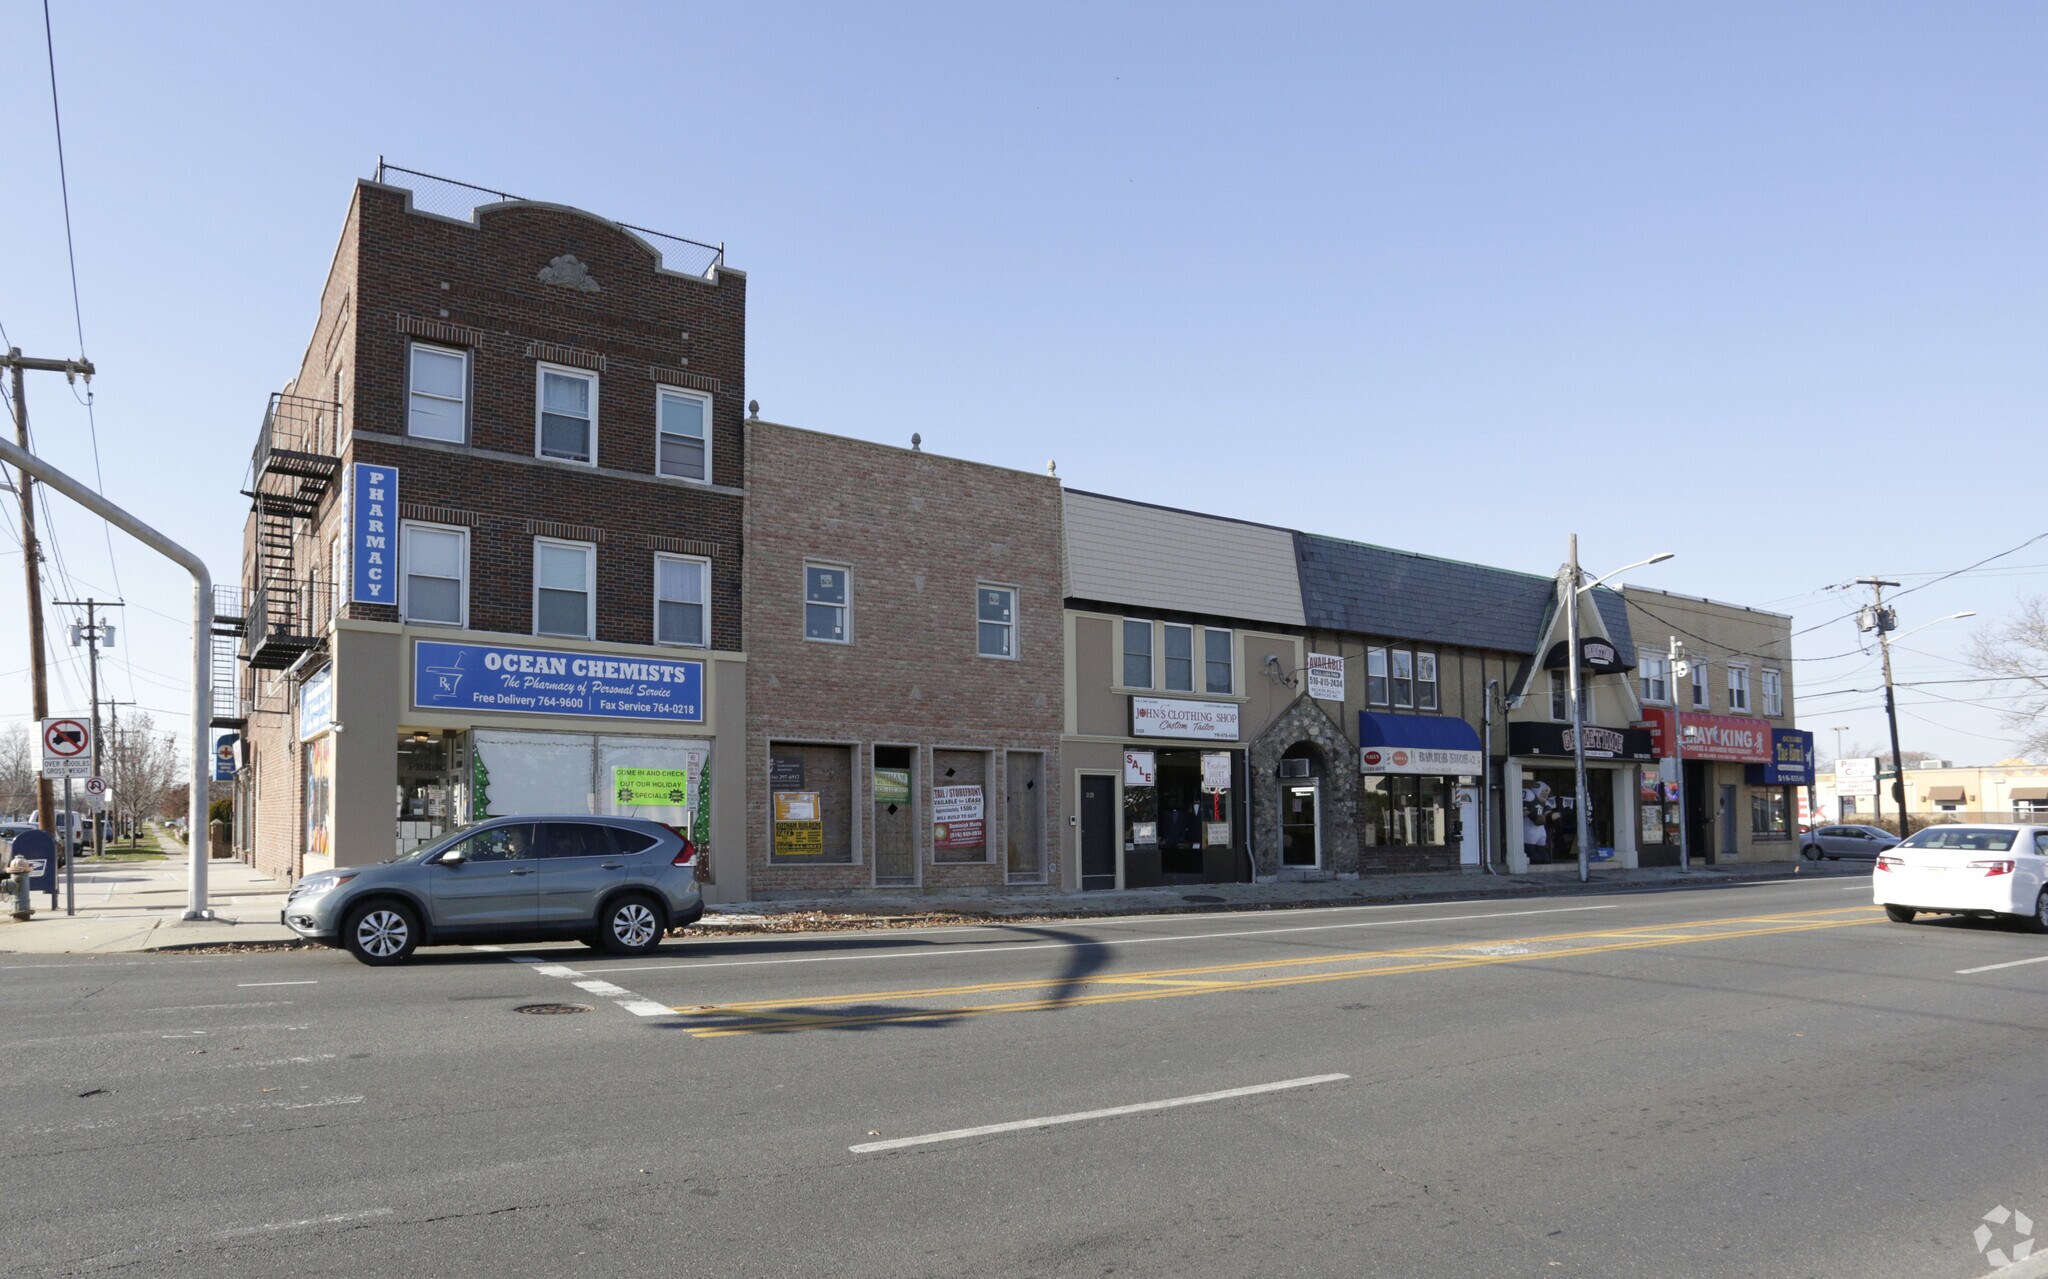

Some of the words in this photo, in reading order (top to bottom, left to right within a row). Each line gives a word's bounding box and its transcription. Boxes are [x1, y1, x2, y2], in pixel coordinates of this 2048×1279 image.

[366, 471, 385, 597] PHARMACY
[484, 652, 566, 675] OCEAN
[571, 659, 686, 684] CHEMISTS
[1309, 656, 1343, 671] AVAILABLE
[501, 674, 520, 688] The
[523, 676, 575, 694] Pharmacy
[577, 681, 588, 696] of
[591, 681, 634, 695] Personal
[636, 684, 671, 698] Service
[473, 692, 495, 704] Free
[497, 693, 536, 708] Delivery
[538, 696, 583, 708] 764-9600
[600, 699, 616, 710] Fax
[618, 701, 651, 712] Service
[652, 703, 695, 715] 764-0218
[1167, 709, 1213, 722] CLOTHING
[1216, 713, 1237, 723] SHOP
[1159, 720, 1188, 730] Custom
[1193, 722, 1216, 731] Tailor
[1721, 729, 1753, 748] KING
[1126, 754, 1152, 782] SALE
[949, 787, 982, 798] STOREFRONT
